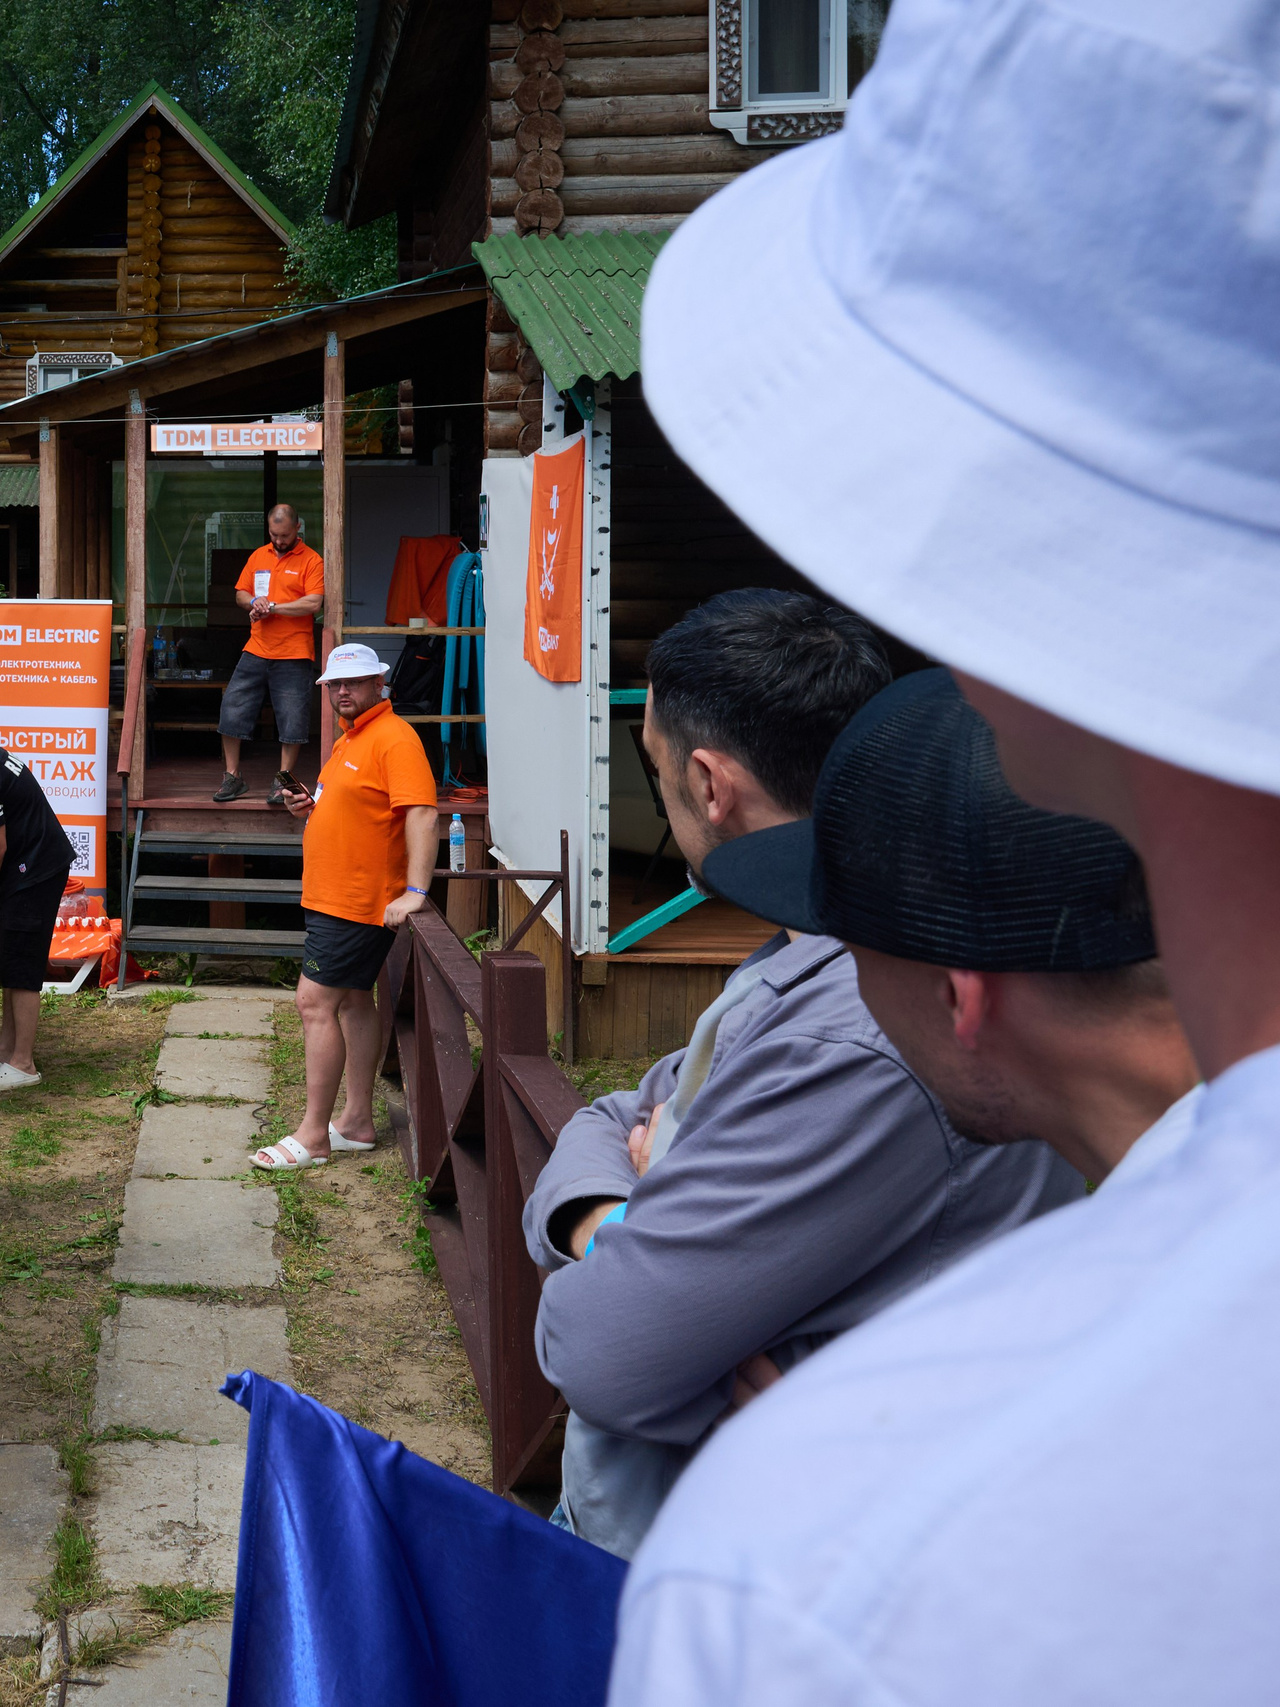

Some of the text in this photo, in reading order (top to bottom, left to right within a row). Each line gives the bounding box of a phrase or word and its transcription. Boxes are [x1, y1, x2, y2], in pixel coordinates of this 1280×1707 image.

[162, 430, 206, 446] TDM
[26, 628, 100, 643] ELECTRIC
[60, 675, 98, 684] КАБЕЛЬ
